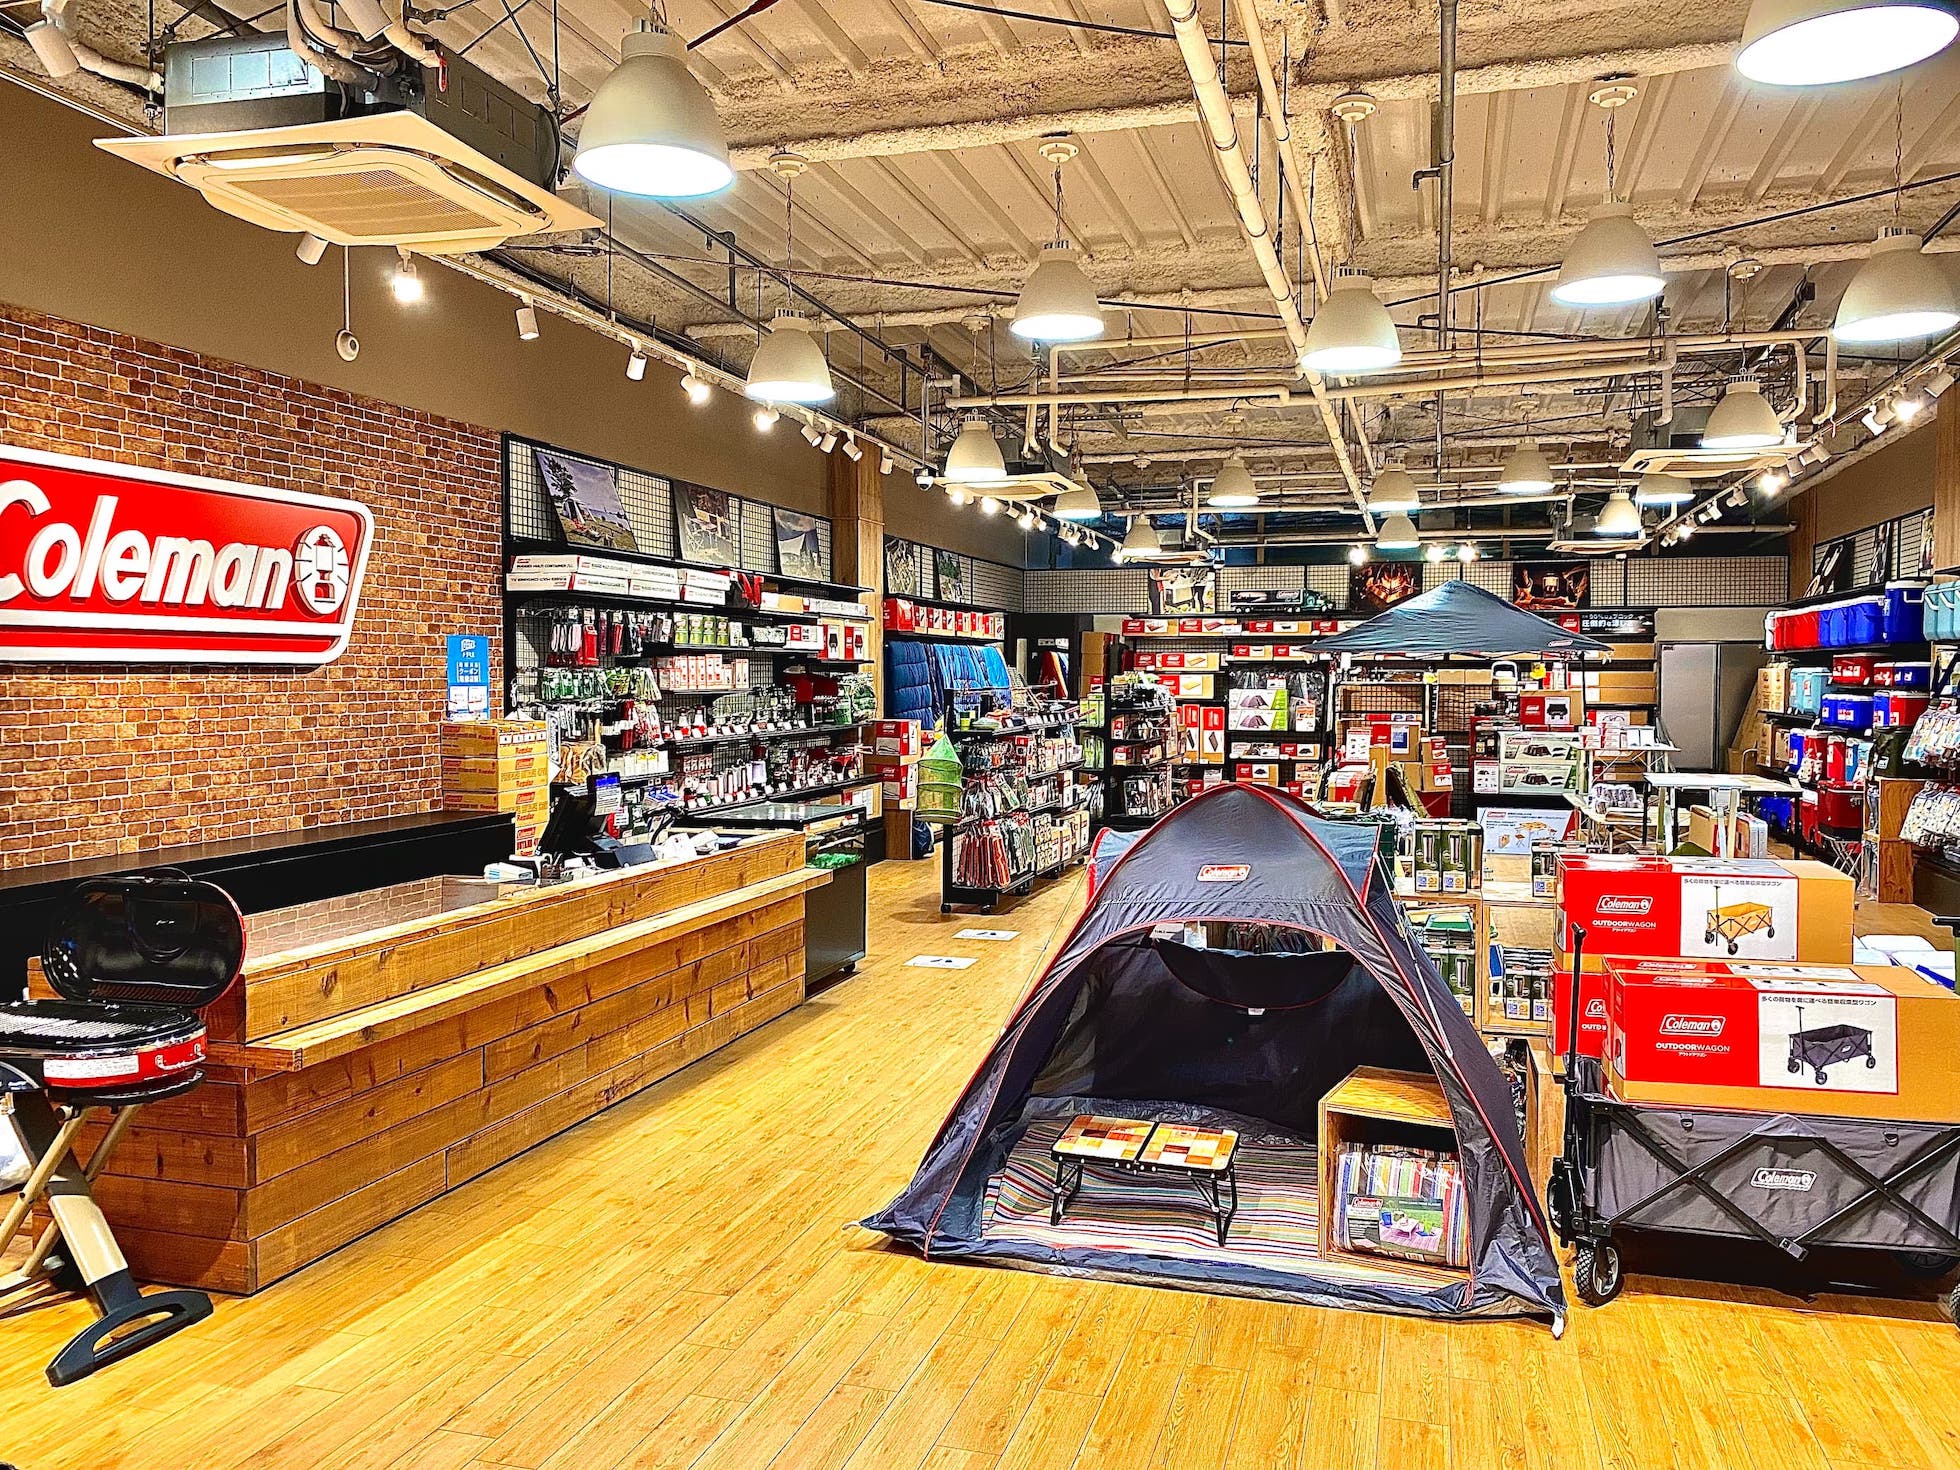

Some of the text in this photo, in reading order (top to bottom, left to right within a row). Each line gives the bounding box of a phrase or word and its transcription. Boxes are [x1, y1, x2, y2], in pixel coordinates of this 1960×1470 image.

[0, 479, 293, 610] Coleman
[1601, 897, 1640, 910] Coleman
[1665, 1016, 1711, 1030] Coleman
[1757, 1170, 1801, 1185] Coleman
